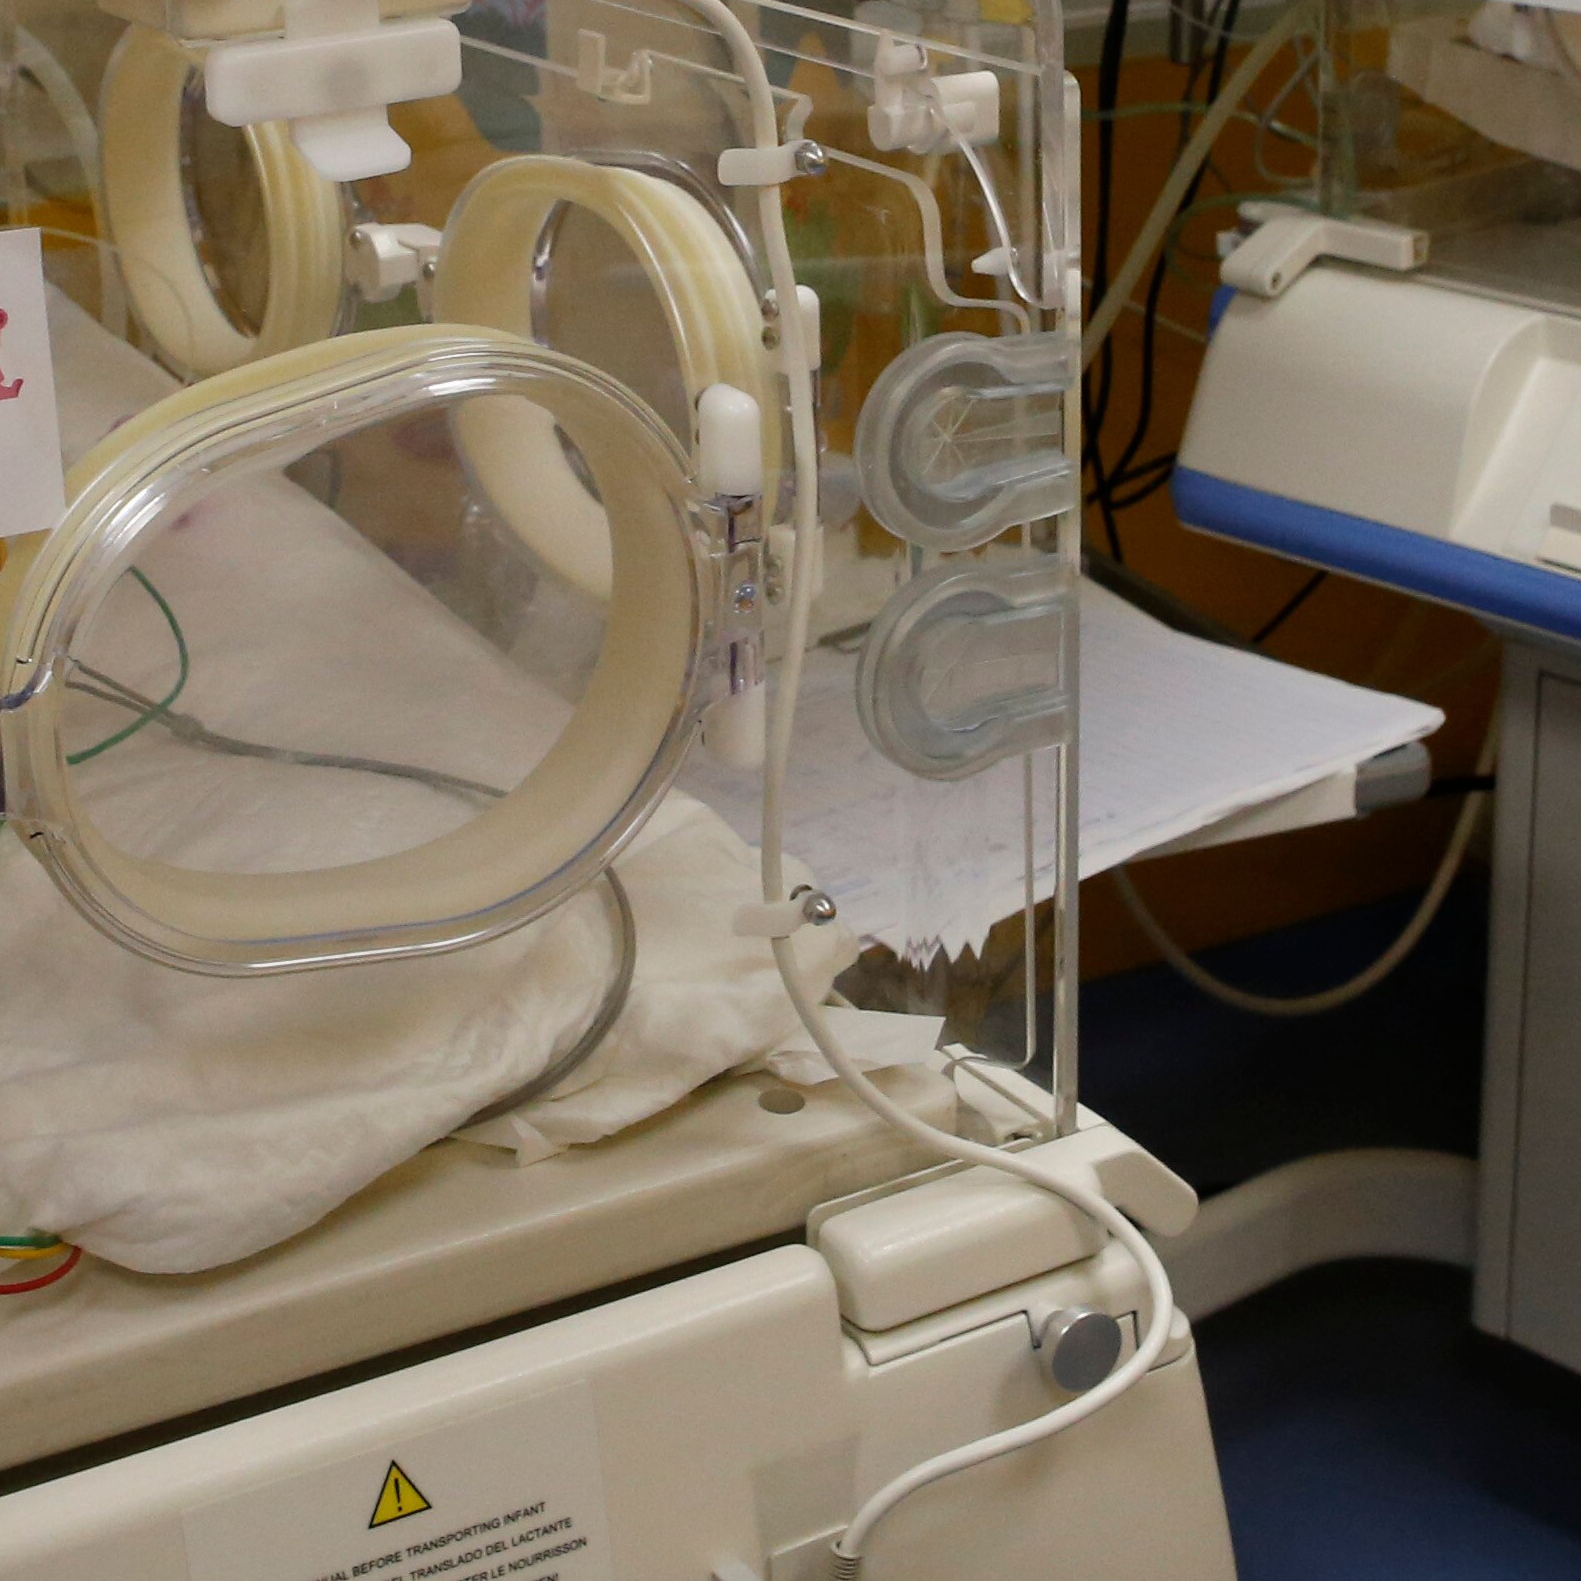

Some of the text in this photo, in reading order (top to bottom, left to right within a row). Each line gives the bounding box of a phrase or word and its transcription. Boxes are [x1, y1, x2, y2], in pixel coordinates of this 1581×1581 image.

[352, 1550, 404, 1577] BEFORE
[406, 1518, 501, 1558] TRANSPORTING
[502, 1501, 546, 1525] INFANT
[485, 1540, 510, 1557] DEL
[511, 1517, 572, 1548] LACTANTE
[490, 1565, 506, 1579] LE
[508, 1536, 588, 1573] NOURRISSON
